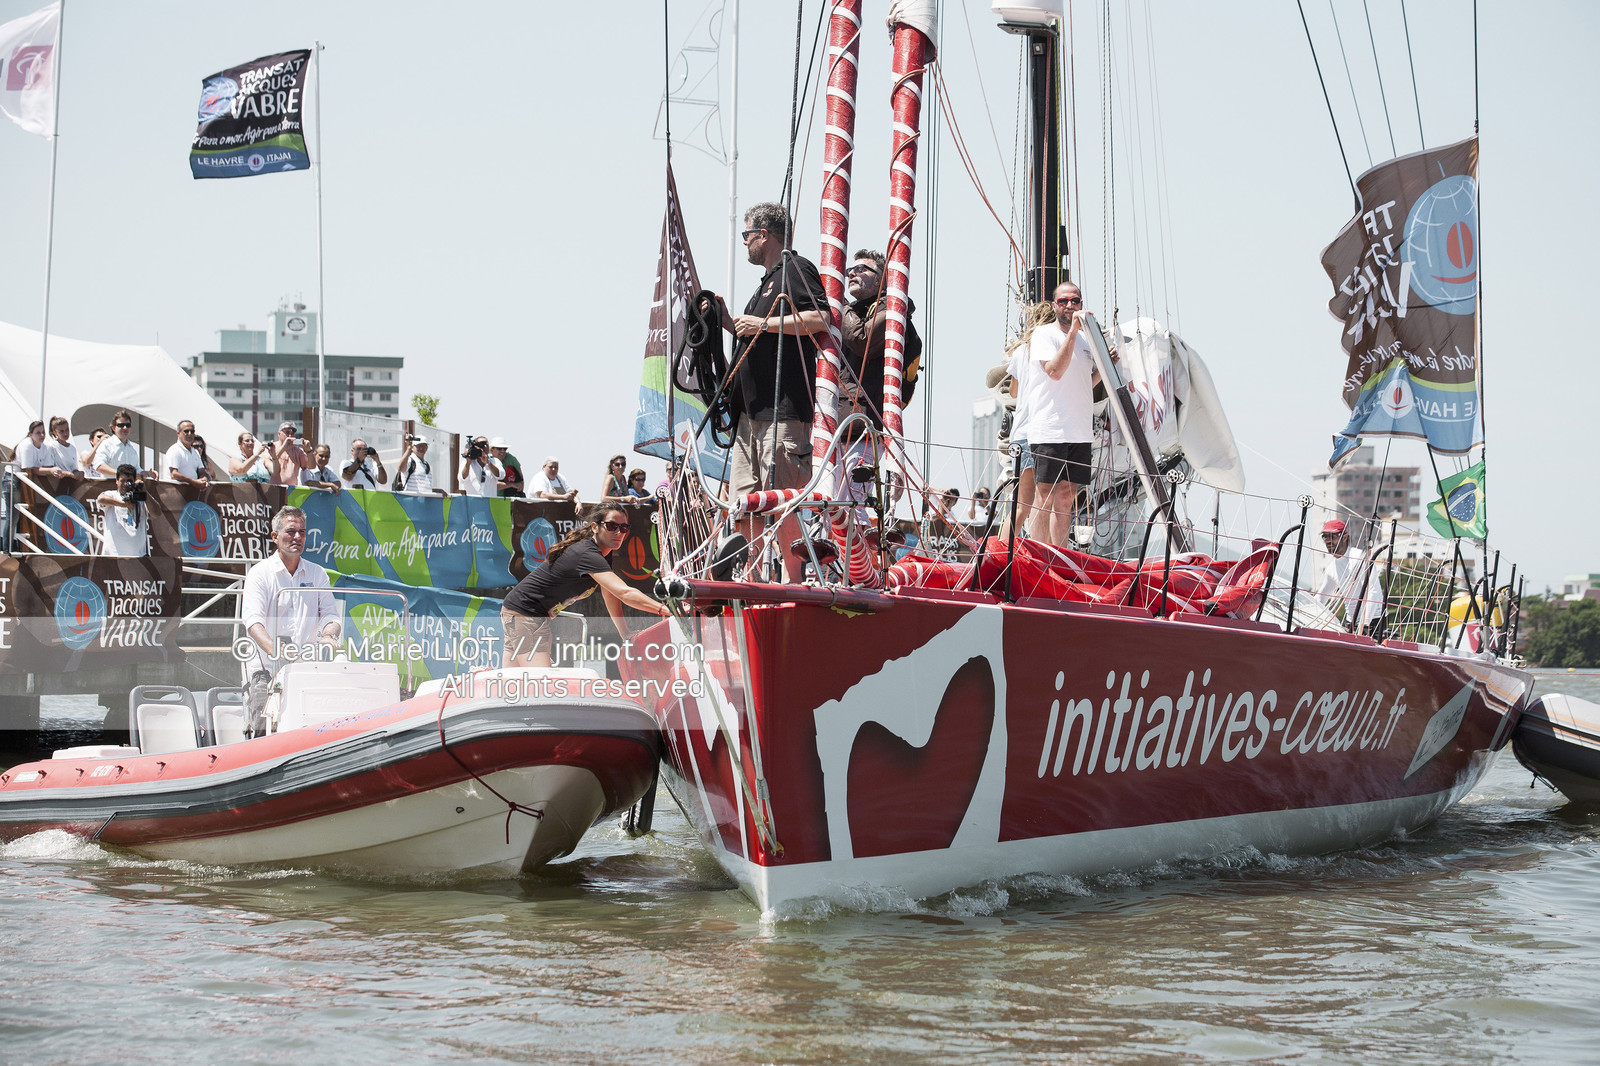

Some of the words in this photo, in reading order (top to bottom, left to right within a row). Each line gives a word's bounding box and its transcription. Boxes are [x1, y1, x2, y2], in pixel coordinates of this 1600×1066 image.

[240, 58, 304, 85] TRANSAT
[230, 88, 299, 119] VABRE
[197, 157, 209, 165] LE
[211, 156, 244, 166] HAVRE
[305, 528, 328, 555] Ir
[325, 540, 360, 563] para
[397, 525, 429, 566] Agir
[427, 530, 457, 559] para
[103, 580, 166, 596] TRANSAT
[100, 616, 167, 648] VABRE
